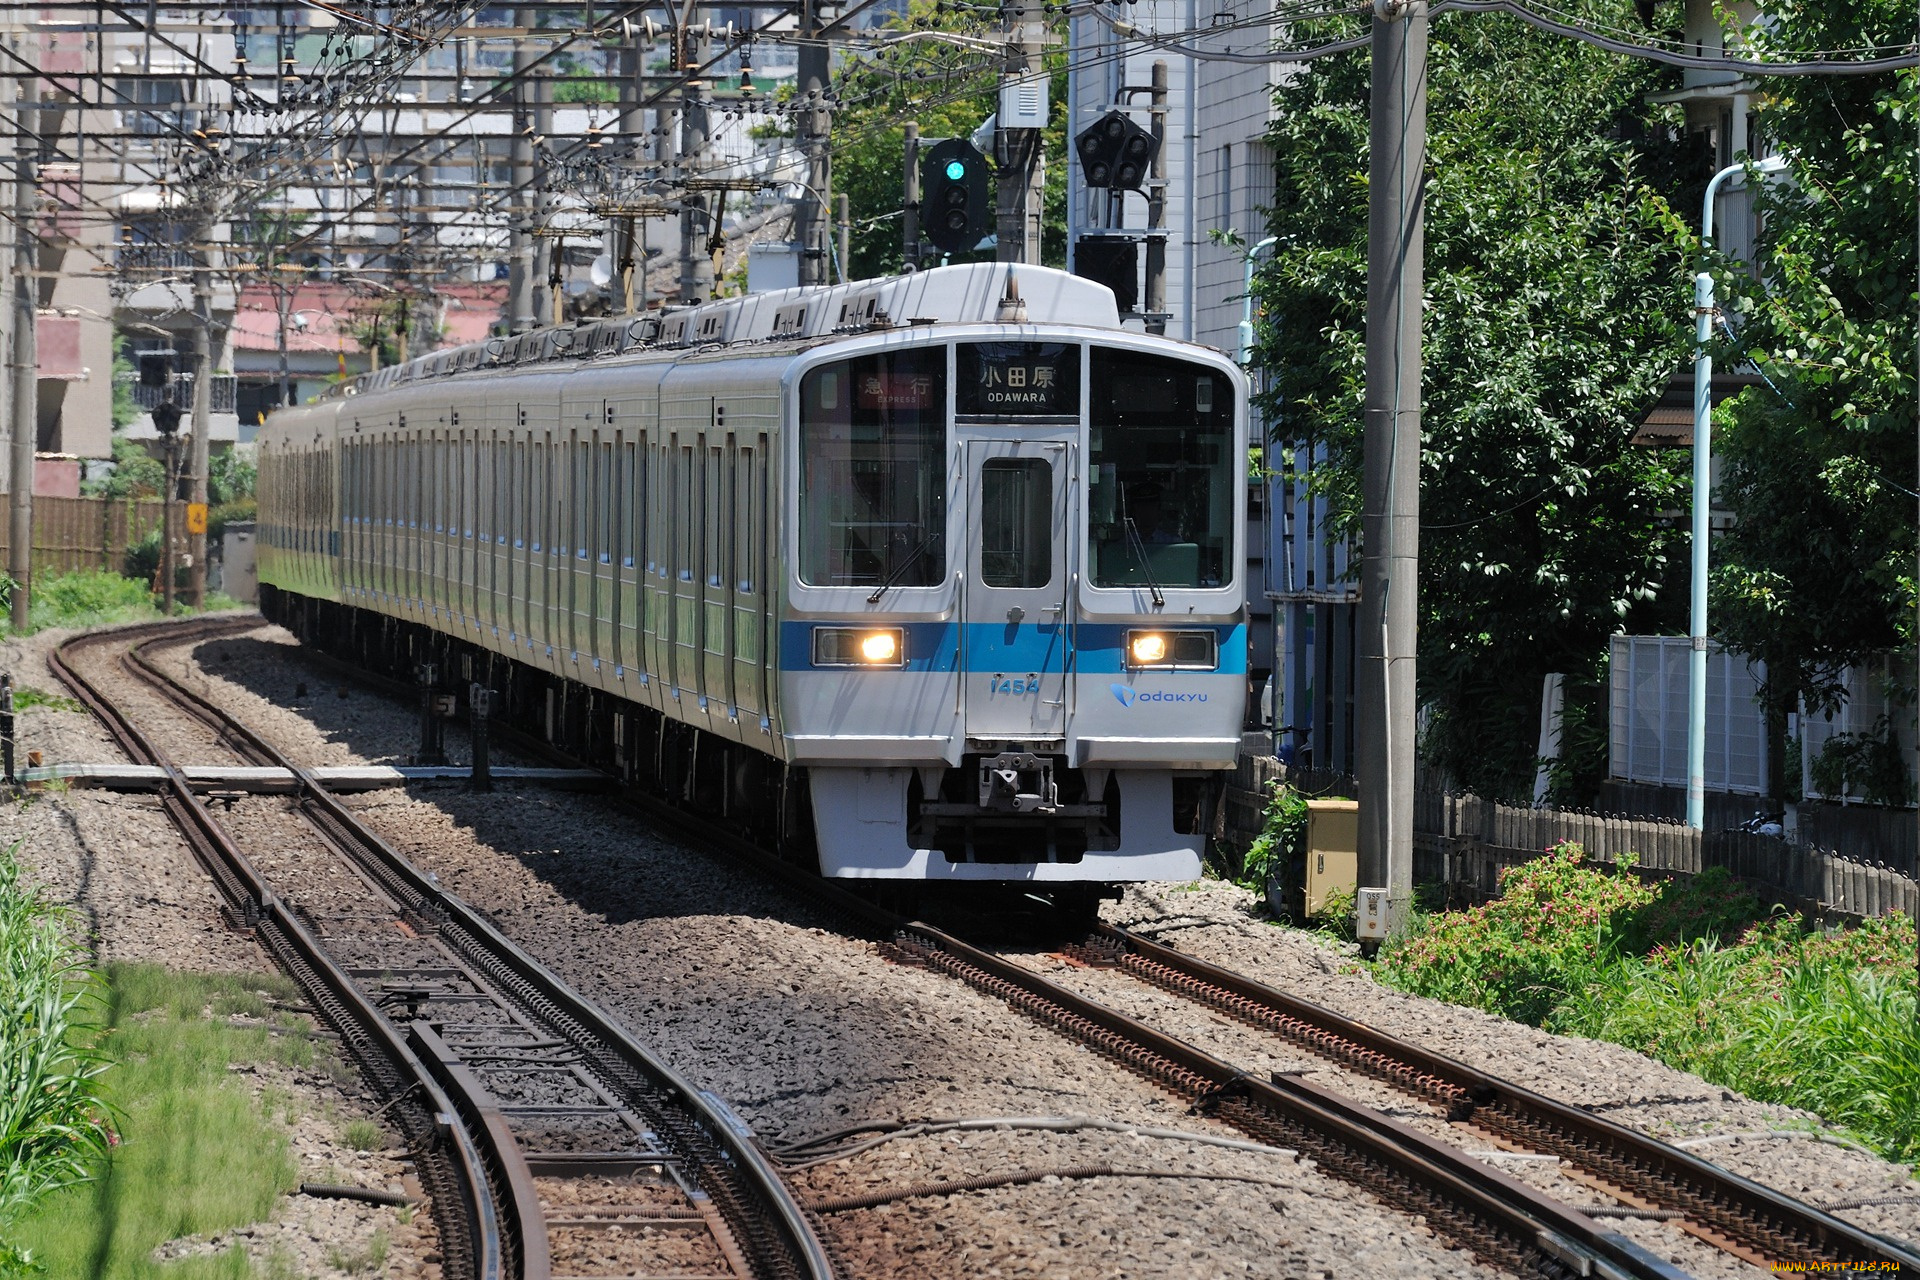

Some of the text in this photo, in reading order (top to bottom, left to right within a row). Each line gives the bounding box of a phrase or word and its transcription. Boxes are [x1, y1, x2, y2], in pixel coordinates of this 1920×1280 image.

[980, 366, 1055, 389] 小田原
[865, 377, 930, 395] 急行
[987, 392, 1046, 403] ODAWARA
[991, 678, 1040, 694] 1454
[1139, 690, 1208, 703] odakyu
